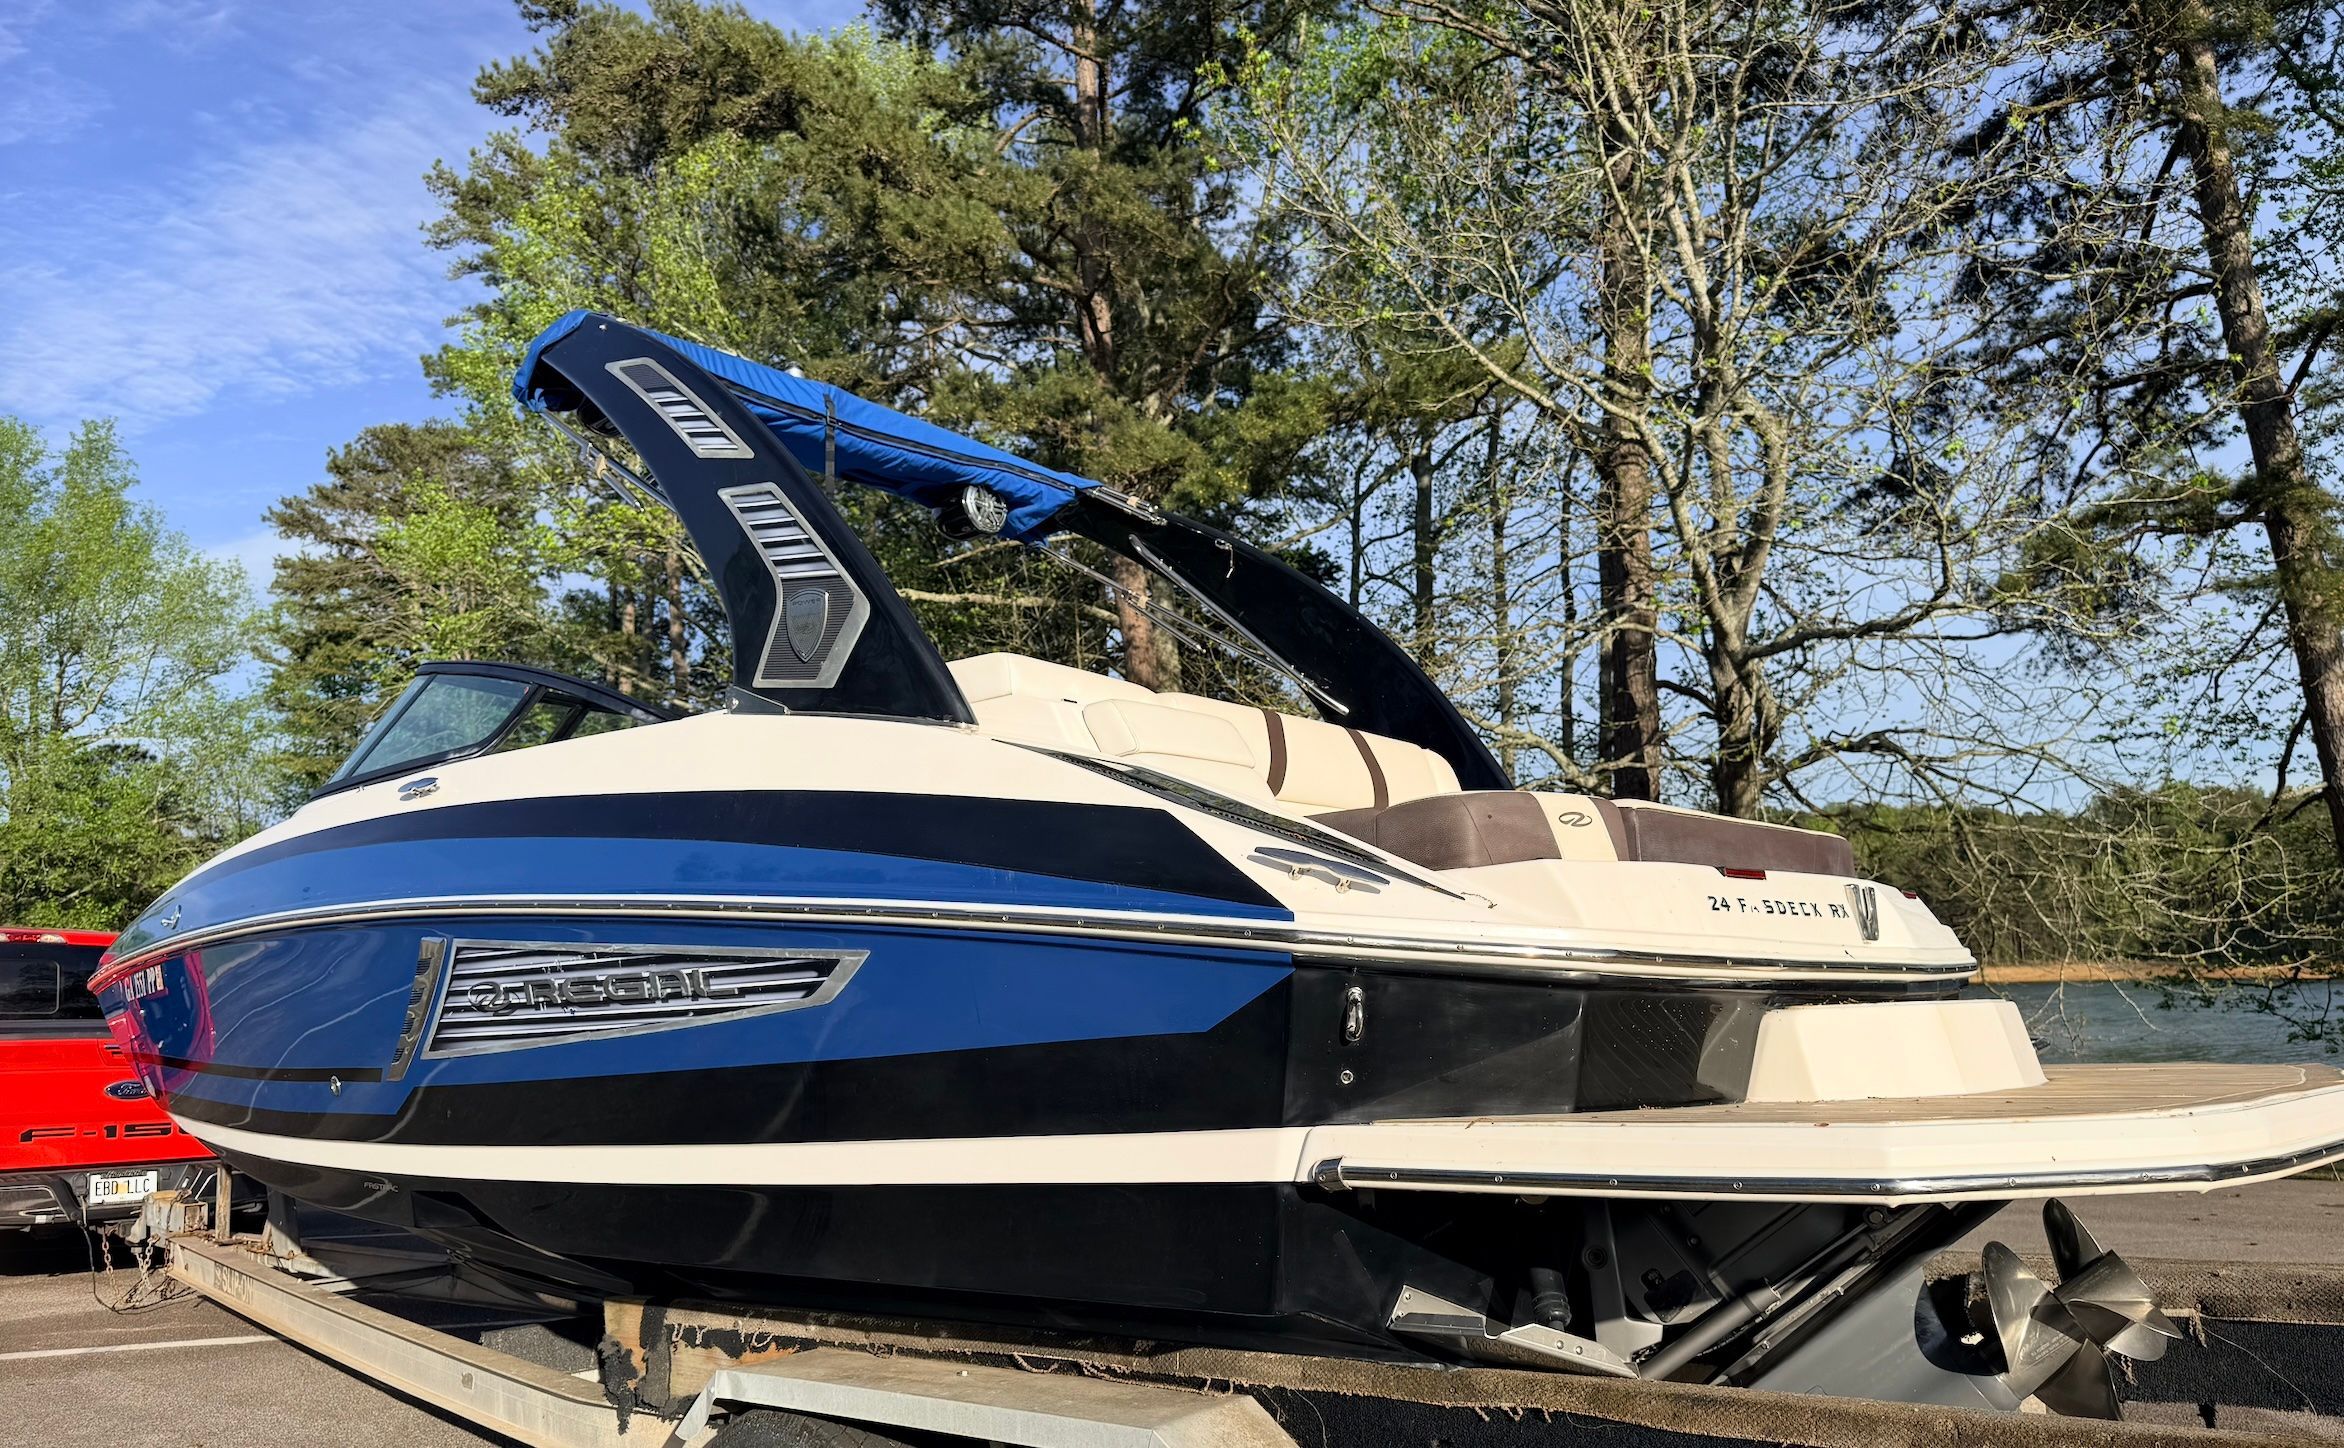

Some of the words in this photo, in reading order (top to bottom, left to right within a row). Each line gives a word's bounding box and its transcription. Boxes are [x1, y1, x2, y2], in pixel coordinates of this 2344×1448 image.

[1707, 895, 1731, 911] 24
[1828, 903, 1850, 918] RX
[524, 969, 739, 1005] REGAL
[20, 1122, 190, 1143] F-15
[95, 1180, 119, 1196] EBD
[127, 1178, 150, 1193] LLC
